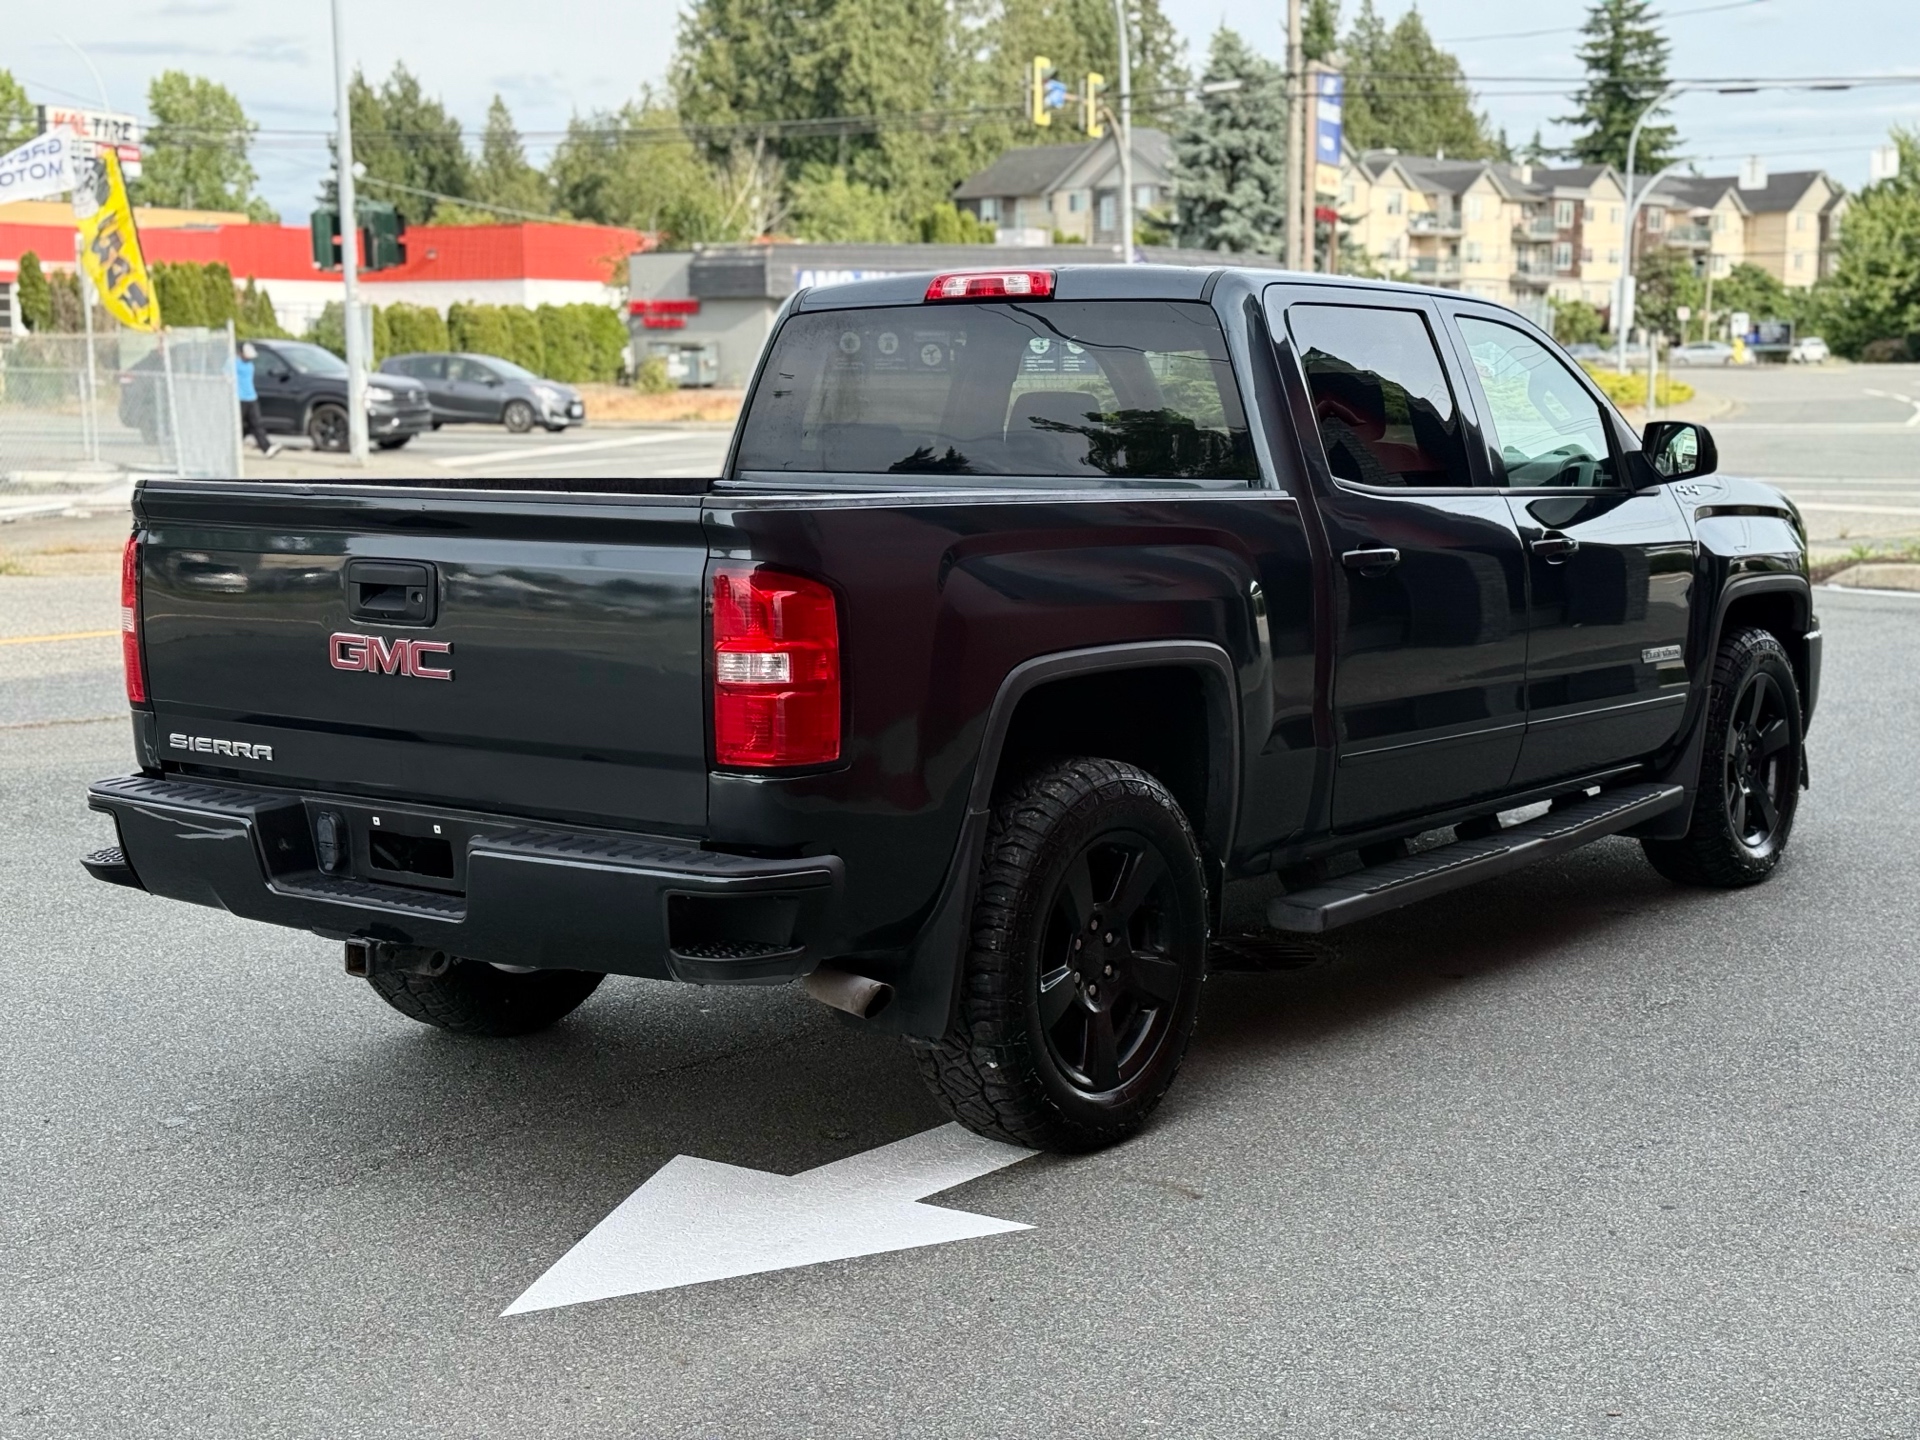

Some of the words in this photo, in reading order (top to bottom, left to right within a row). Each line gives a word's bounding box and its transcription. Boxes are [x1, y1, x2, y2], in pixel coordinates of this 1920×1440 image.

[92, 117, 131, 141] TIRE
[329, 632, 453, 681] GMC
[169, 733, 274, 761] SIERRA
